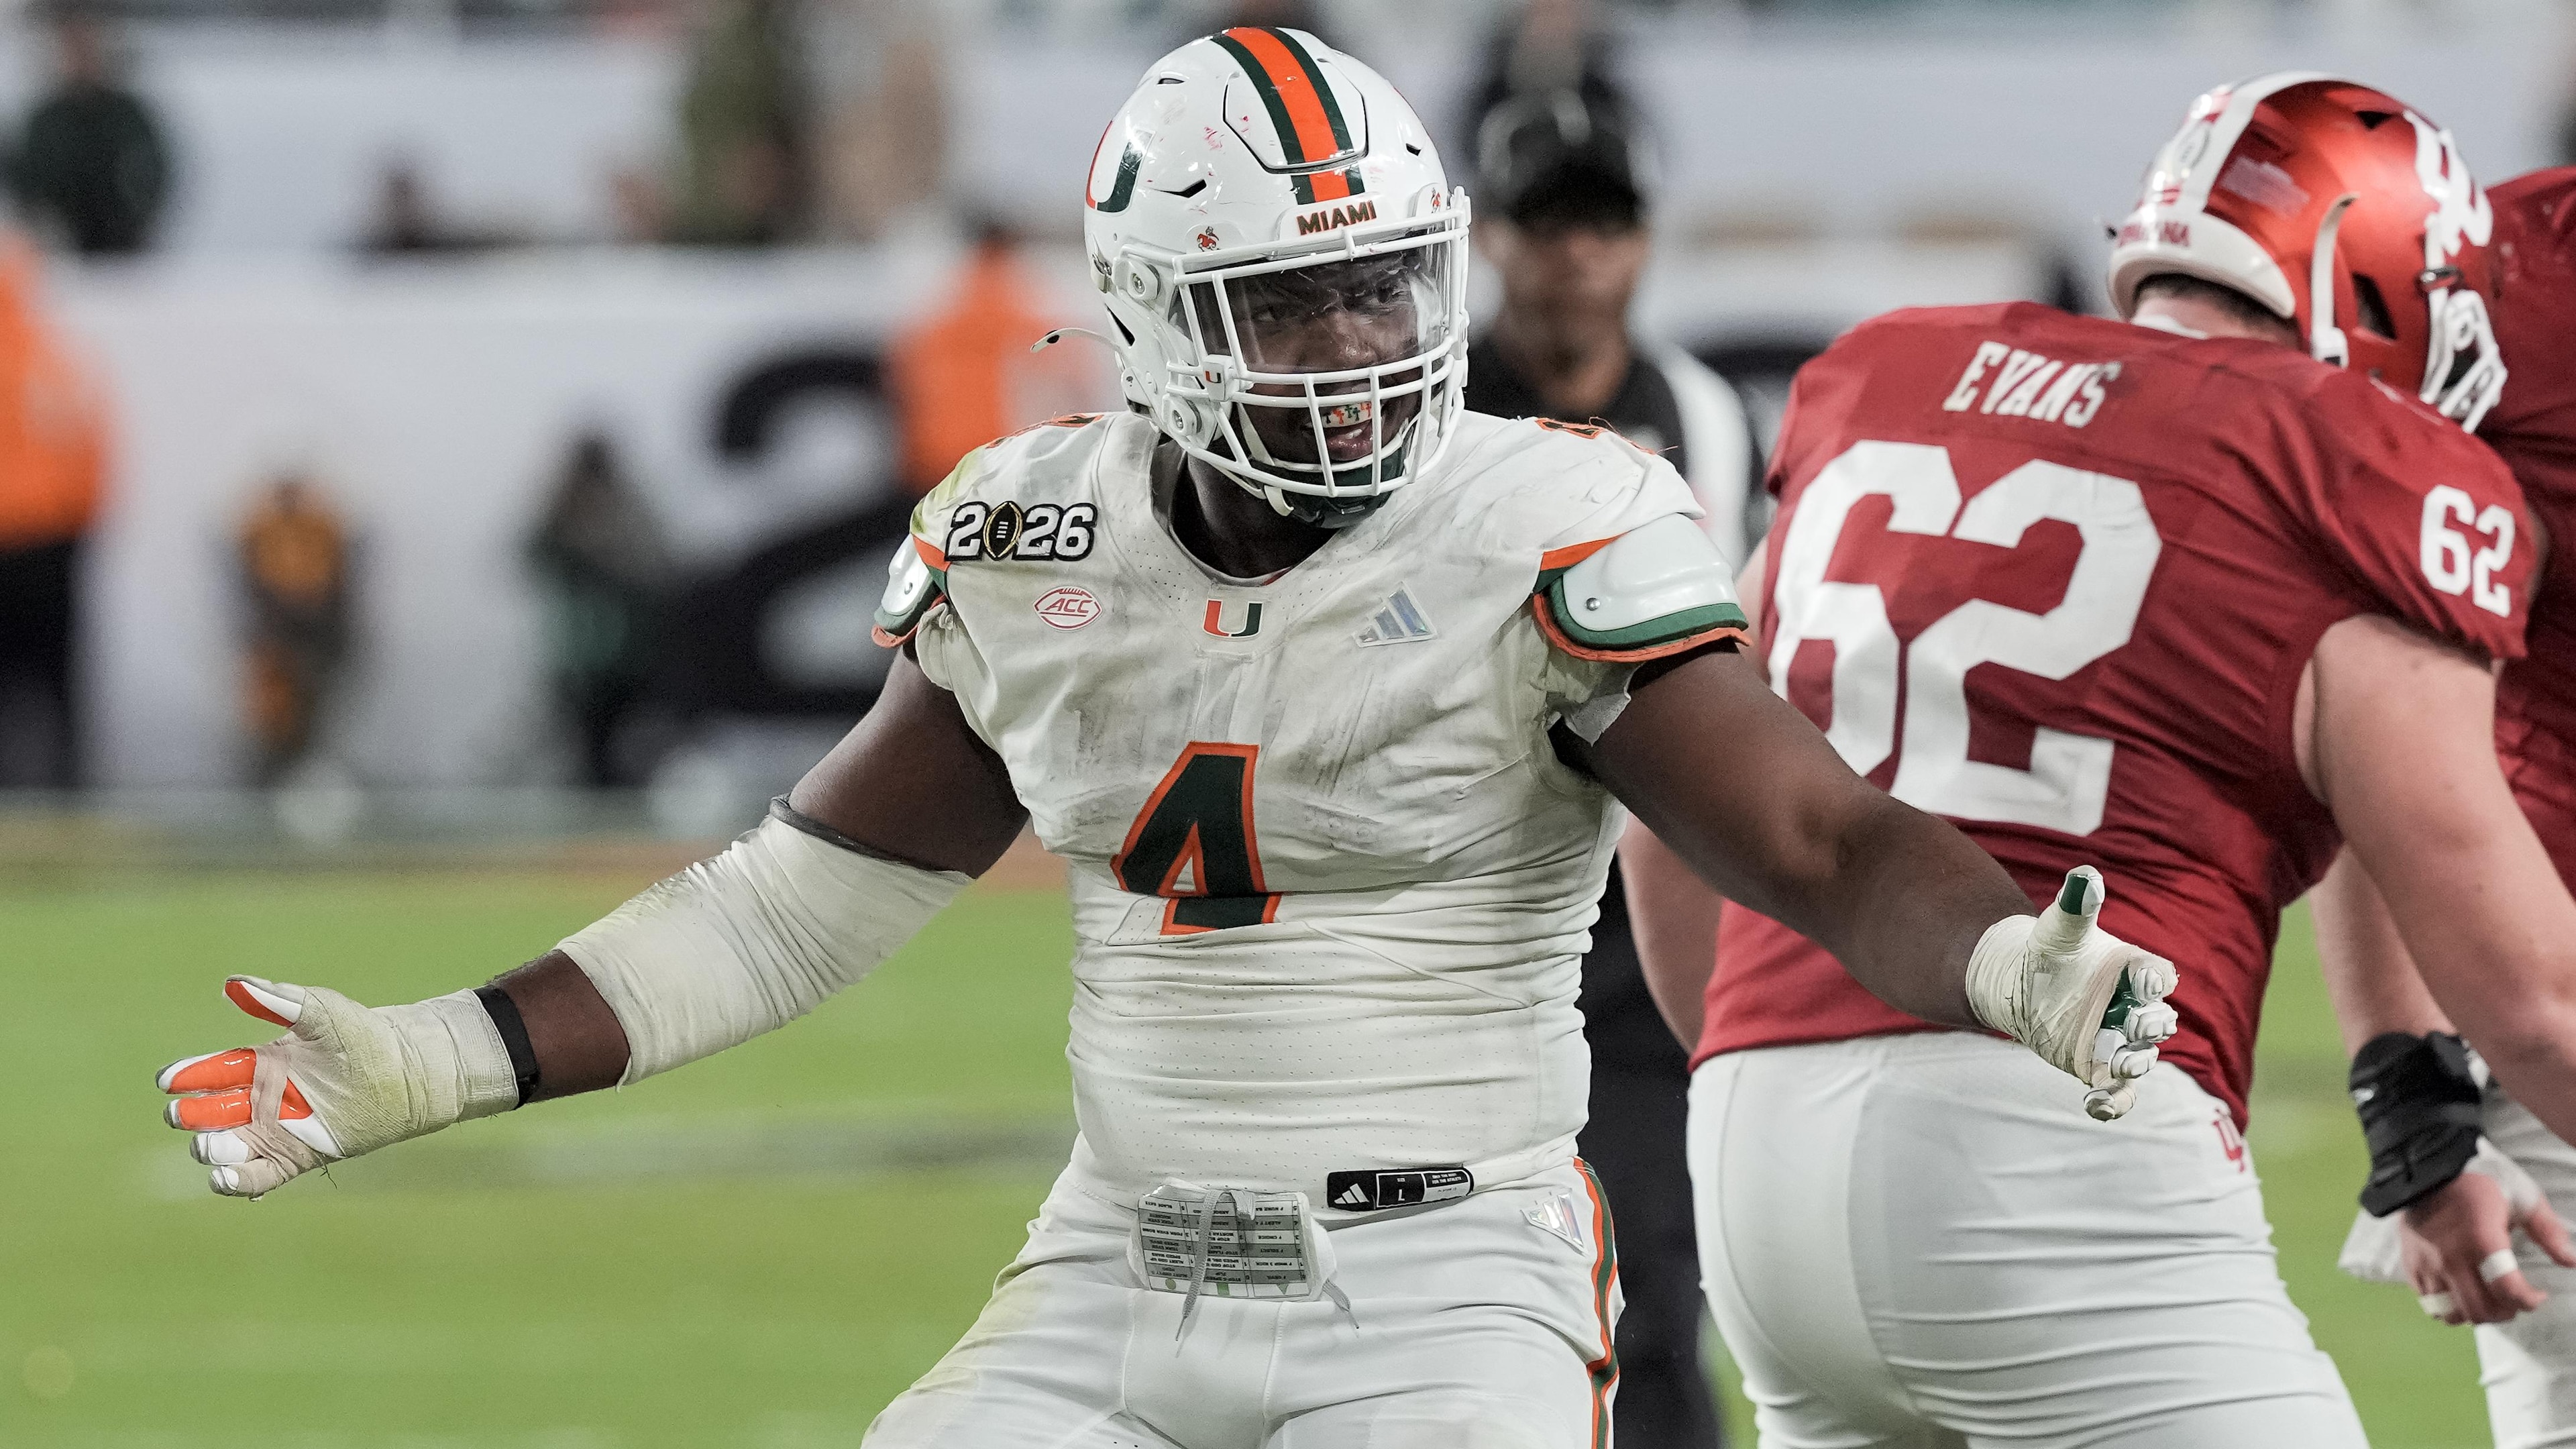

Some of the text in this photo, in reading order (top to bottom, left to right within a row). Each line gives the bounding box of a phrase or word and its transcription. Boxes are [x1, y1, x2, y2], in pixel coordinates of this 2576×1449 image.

[1296, 200, 1378, 236] MIAMI
[1943, 340, 2123, 429] EVANS
[2420, 484, 2516, 617] 62
[1046, 596, 1091, 615] ACC
[1203, 598, 1263, 639] U
[1768, 439, 2163, 837] 62
[1110, 740, 1283, 936] 4
[1398, 1189, 1405, 1201] L
